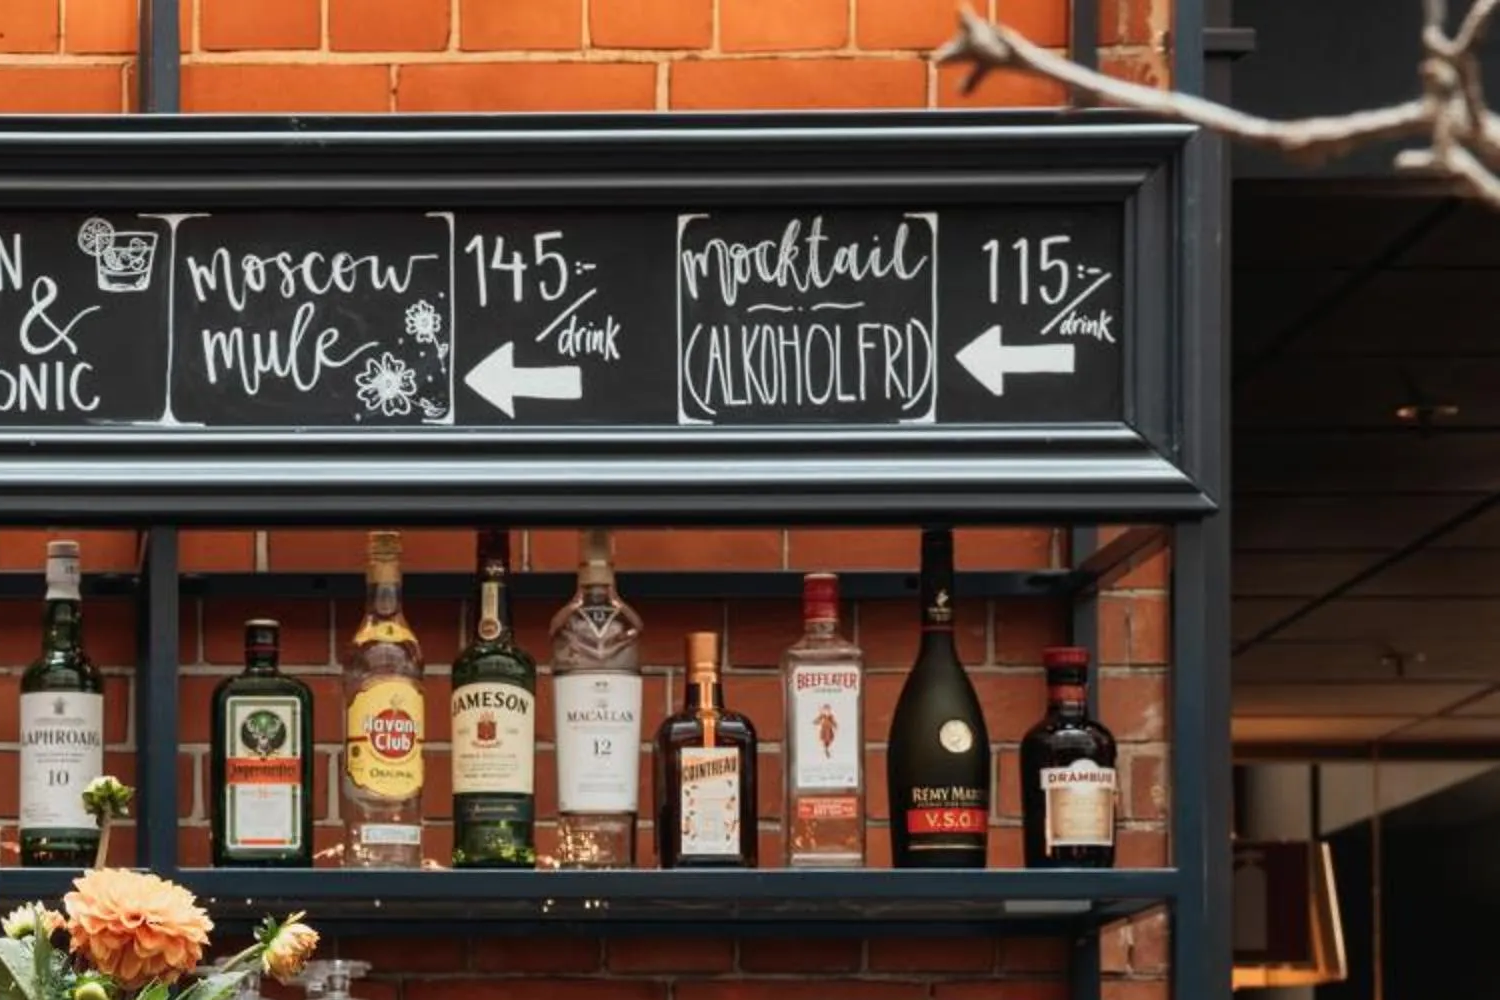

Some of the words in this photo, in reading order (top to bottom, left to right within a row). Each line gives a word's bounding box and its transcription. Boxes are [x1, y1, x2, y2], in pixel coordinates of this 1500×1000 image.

[19, 276, 101, 355] &
[797, 672, 857, 691] BEEFEATER
[452, 691, 529, 716] JAMESON
[375, 733, 412, 751] Club
[592, 741, 612, 756] 12
[48, 770, 69, 787] 10
[682, 757, 737, 781] COINTREAU
